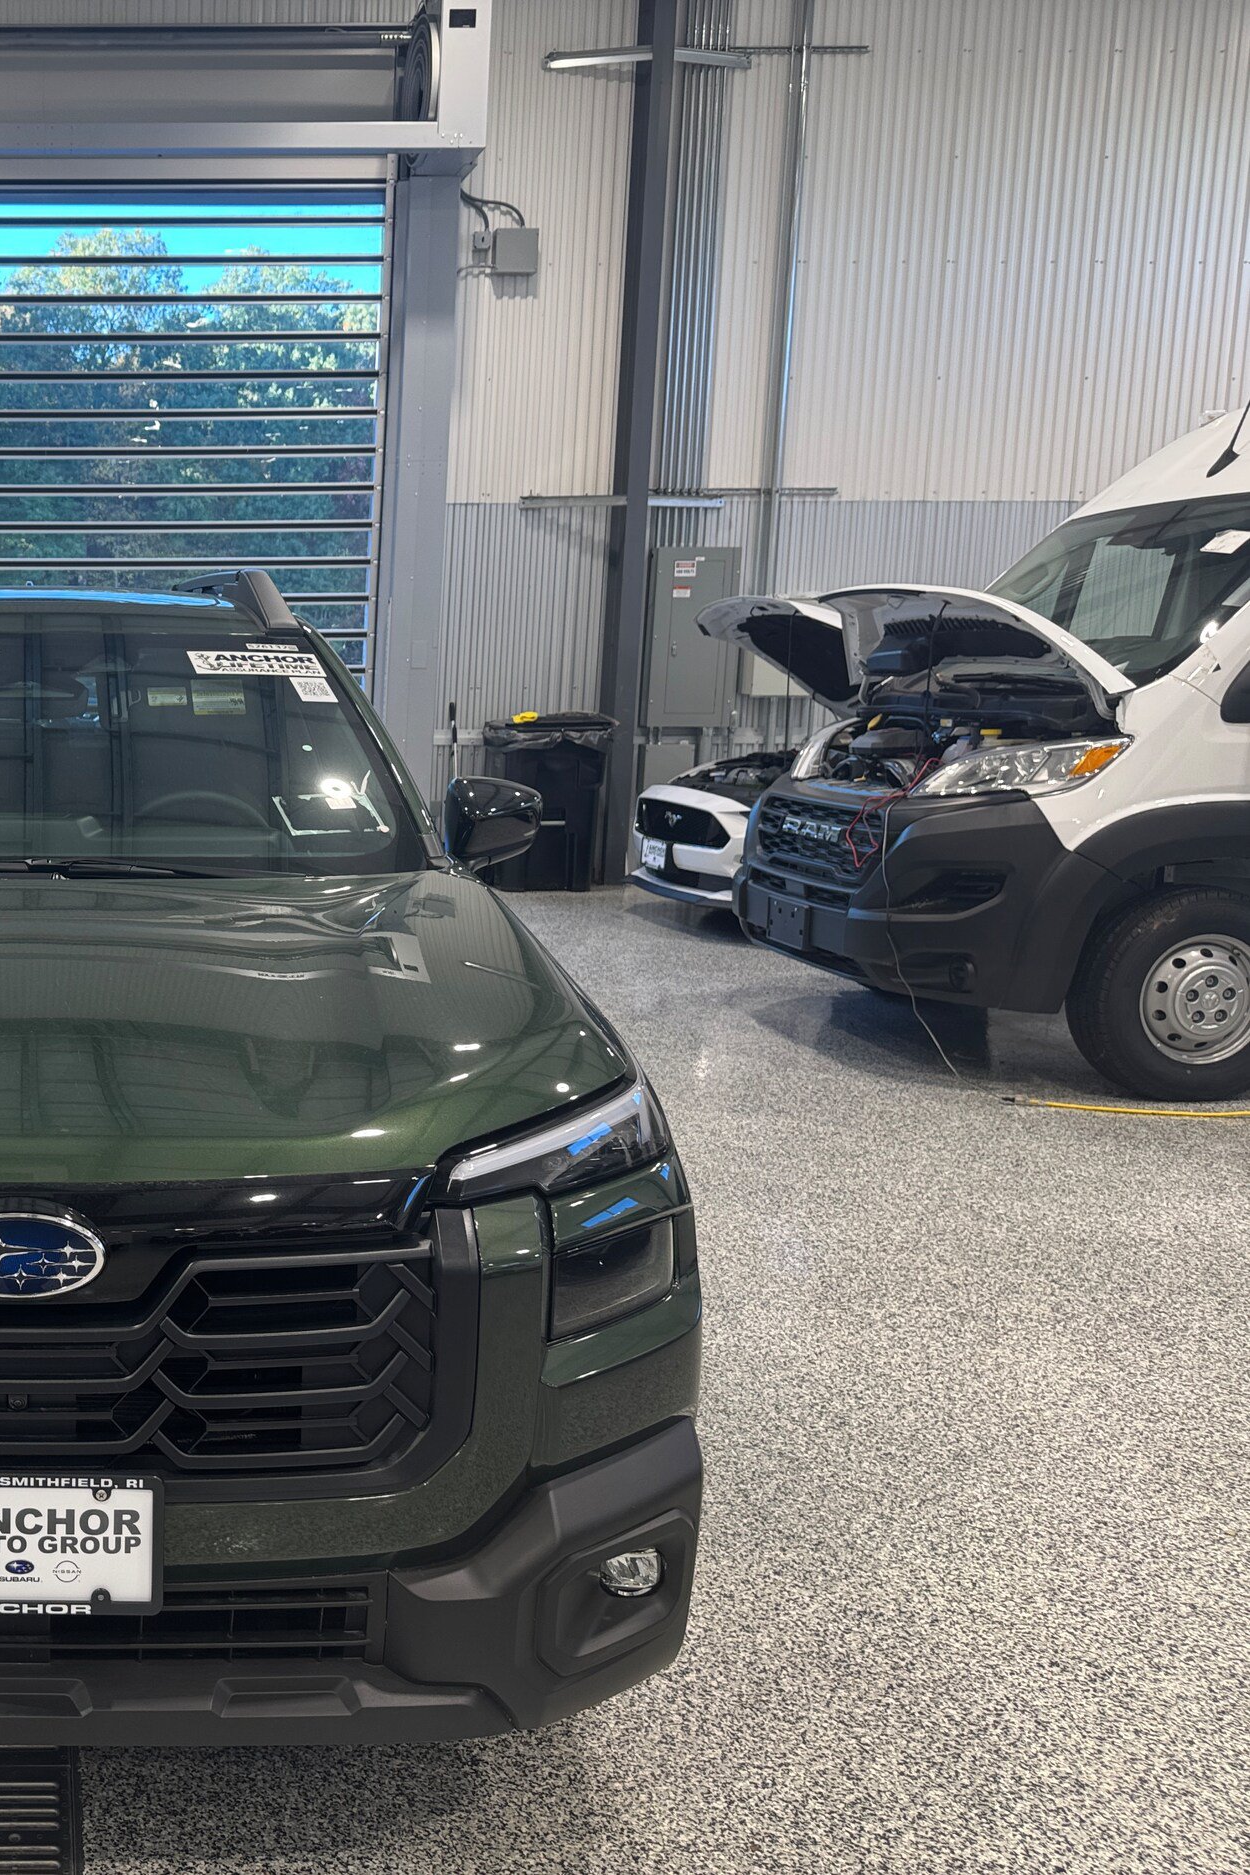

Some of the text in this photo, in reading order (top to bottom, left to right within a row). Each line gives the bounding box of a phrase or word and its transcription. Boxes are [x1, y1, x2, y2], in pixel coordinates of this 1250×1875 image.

[215, 654, 315, 664] ANCHOR
[217, 662, 319, 671] LIFETIME
[782, 815, 842, 843] RAM
[0, 1477, 118, 1489] SMITHFIELD,
[126, 1479, 144, 1488] RI
[38, 1536, 142, 1554] GROUP
